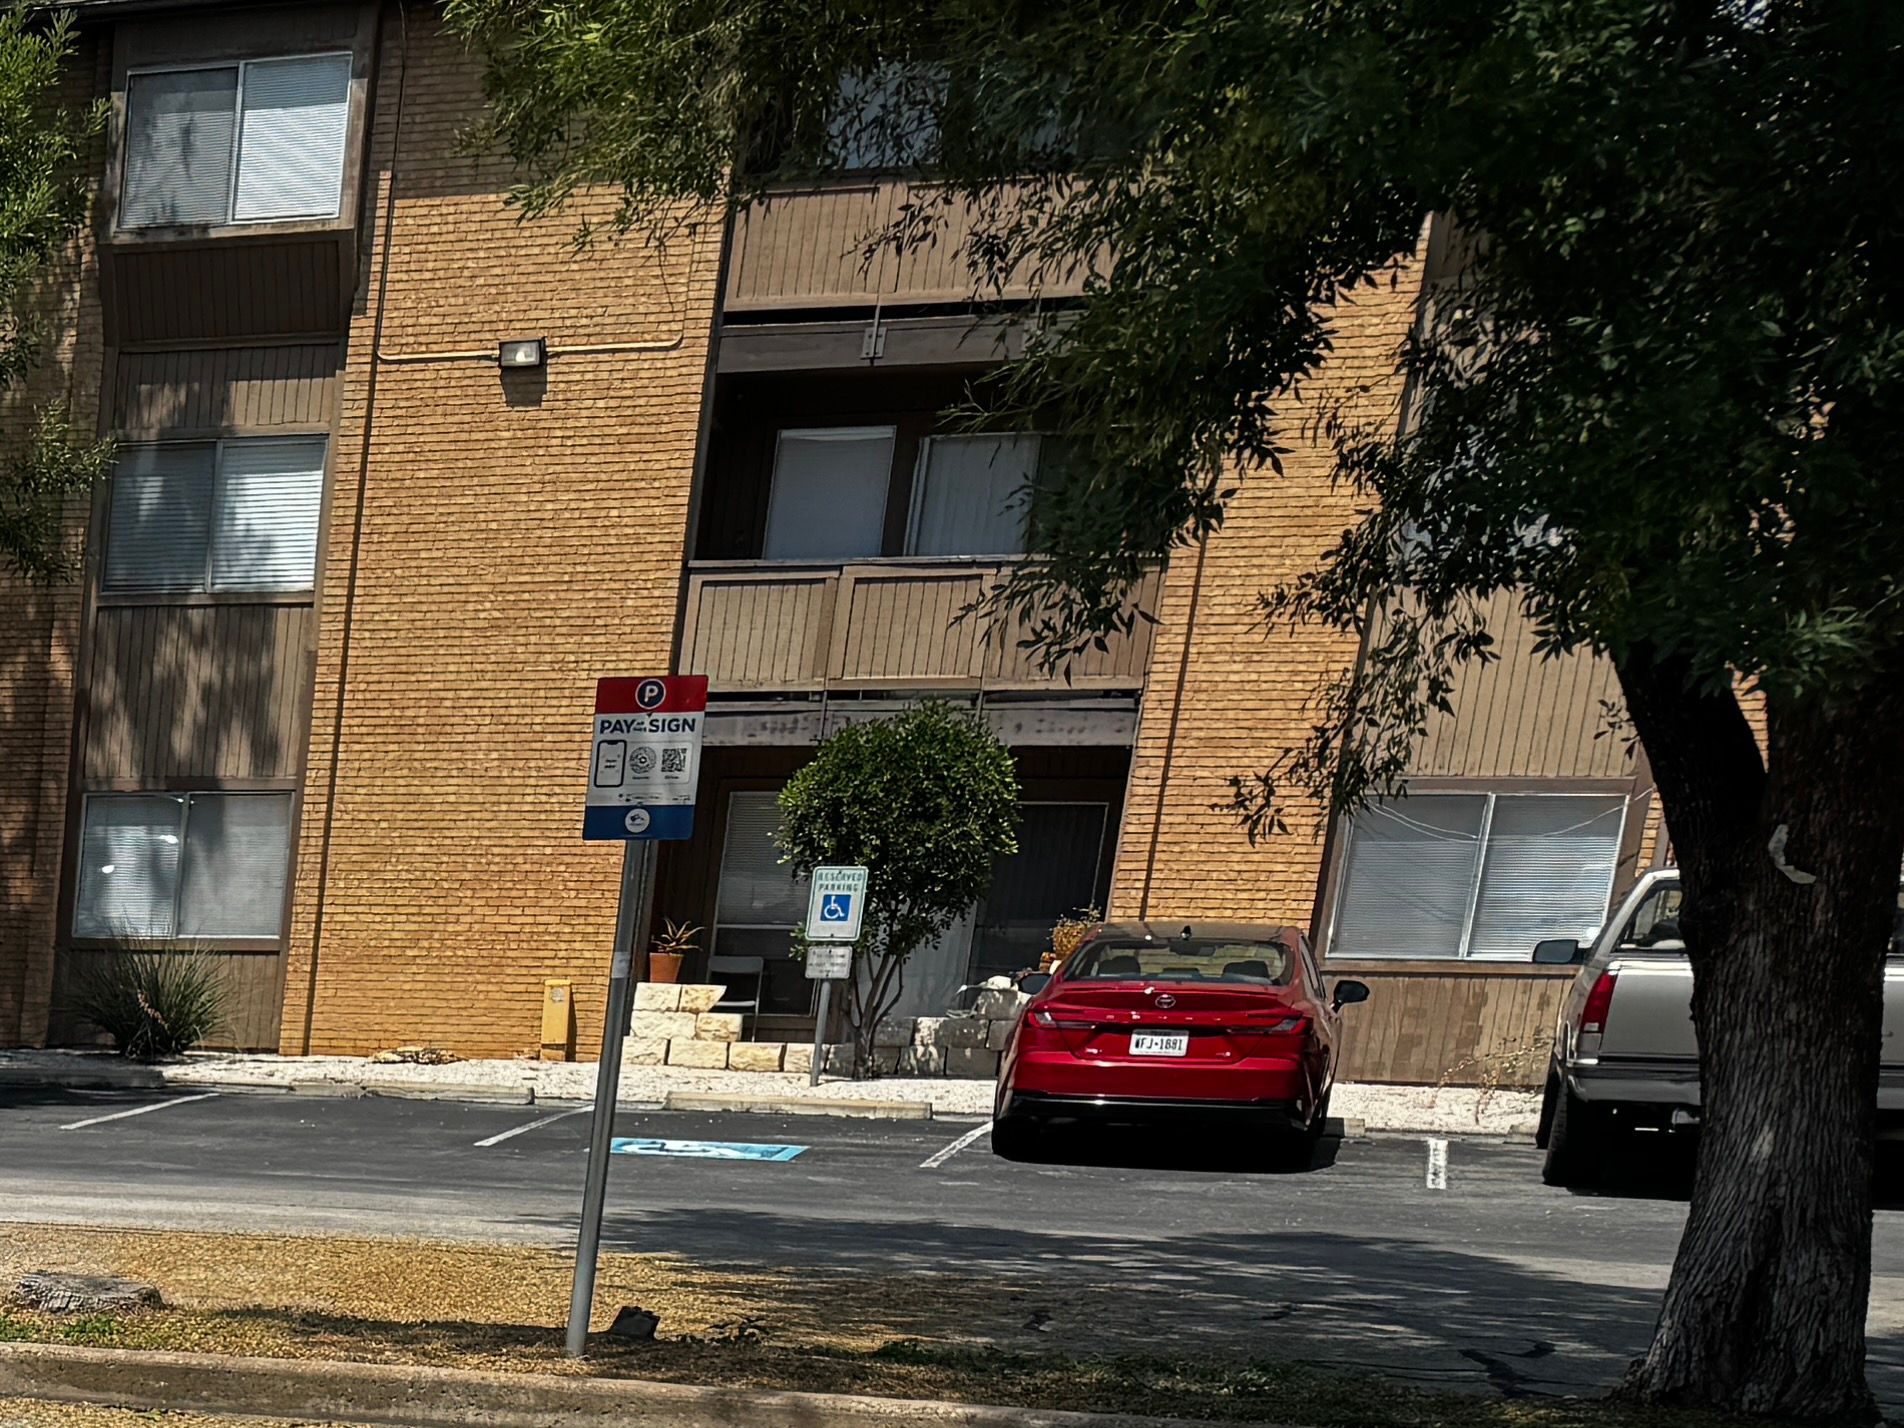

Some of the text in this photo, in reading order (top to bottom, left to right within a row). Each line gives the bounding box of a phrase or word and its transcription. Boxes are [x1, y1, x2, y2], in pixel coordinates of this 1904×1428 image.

[644, 685, 659, 703] P
[599, 718, 636, 735] PAY
[648, 717, 696, 733] SIGN
[817, 872, 863, 881] RESERVED
[818, 883, 859, 892] PARKING
